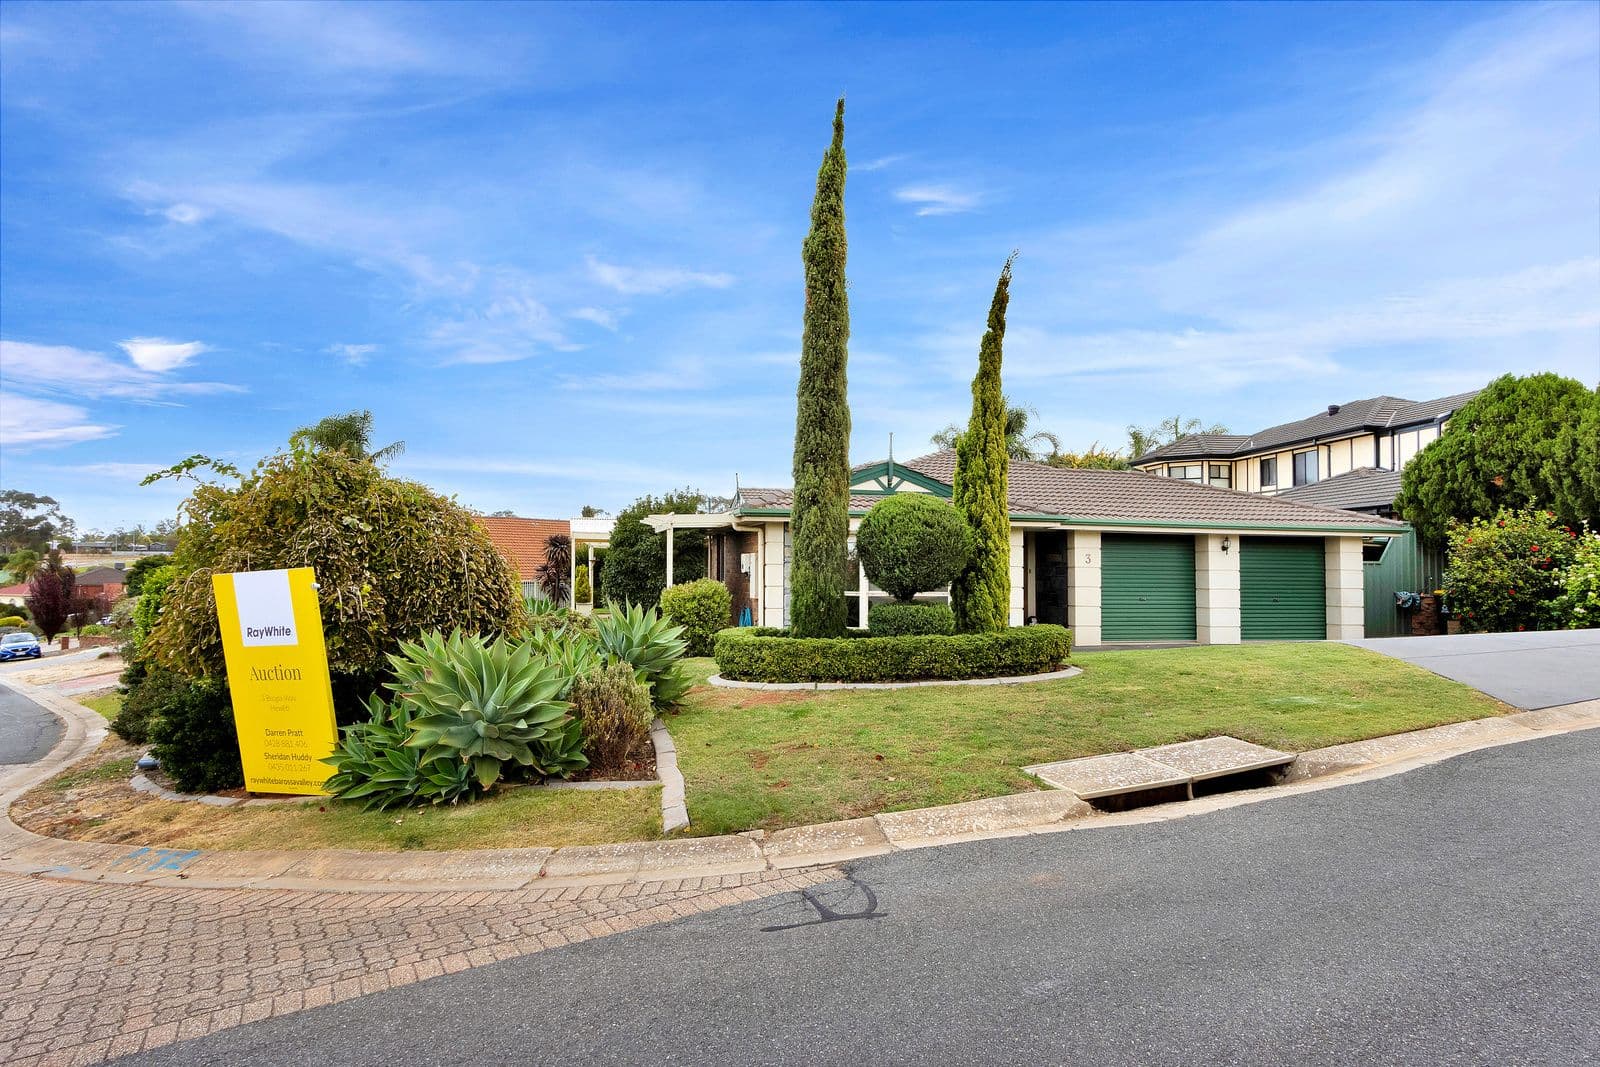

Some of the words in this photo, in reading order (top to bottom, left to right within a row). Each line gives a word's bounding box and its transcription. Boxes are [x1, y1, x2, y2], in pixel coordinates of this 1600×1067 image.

[1085, 554, 1091, 564] 3
[247, 626, 291, 639] RayWhite
[250, 664, 302, 681] Auction
[265, 728, 287, 737] Darren
[287, 729, 304, 737] Pratt
[264, 752, 291, 761] Sheridan
[291, 753, 312, 762] Huddy
